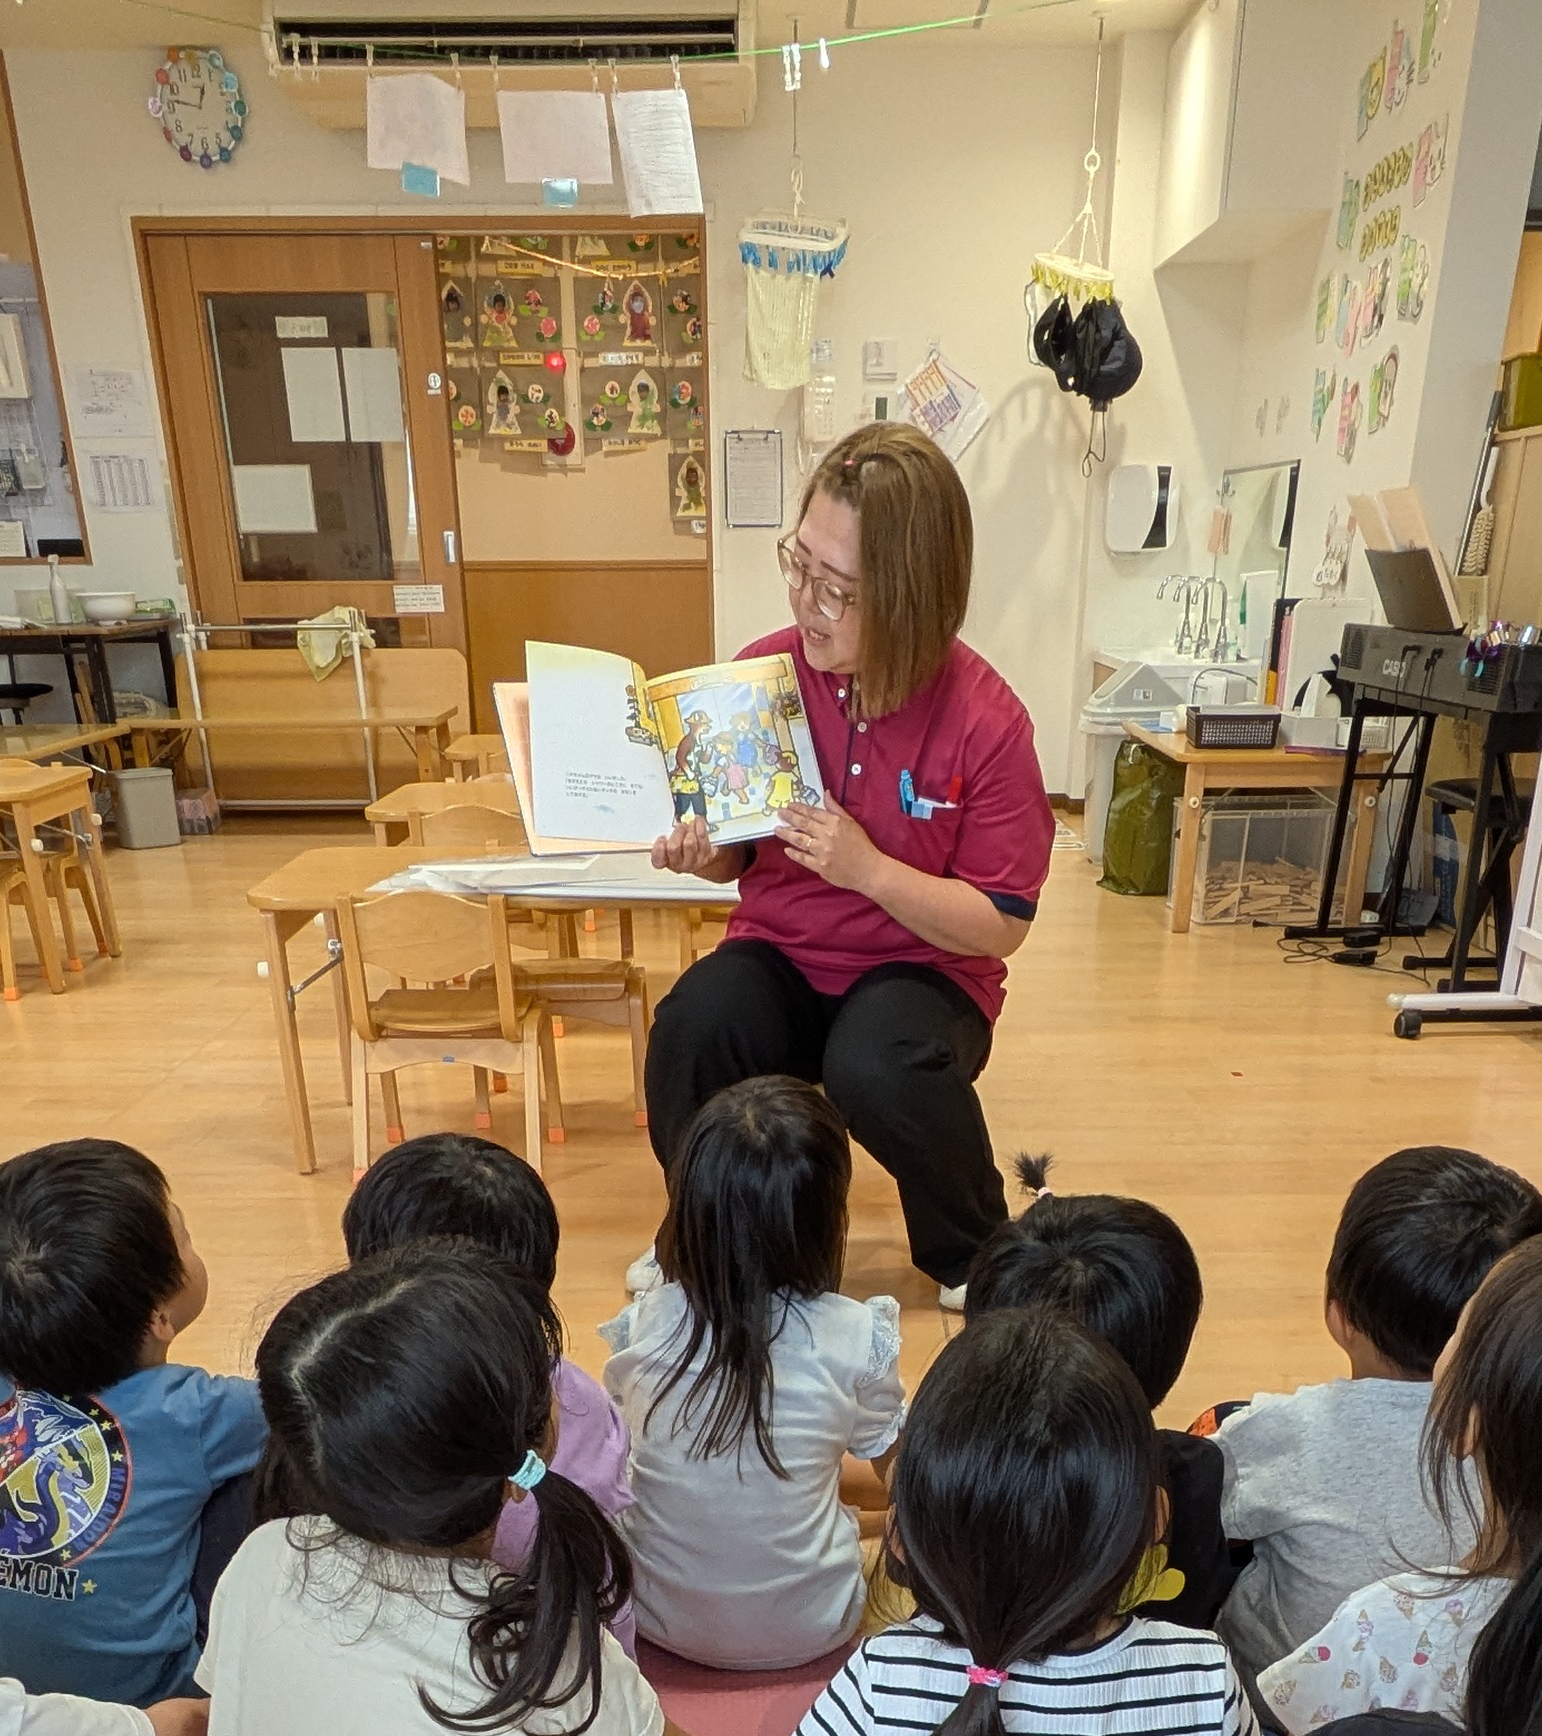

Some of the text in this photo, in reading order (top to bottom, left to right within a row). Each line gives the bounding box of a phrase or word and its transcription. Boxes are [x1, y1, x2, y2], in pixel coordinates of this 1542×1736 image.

[175, 120, 183, 133] 8
[201, 136, 210, 150] 6
[1382, 659, 1407, 679] CASO
